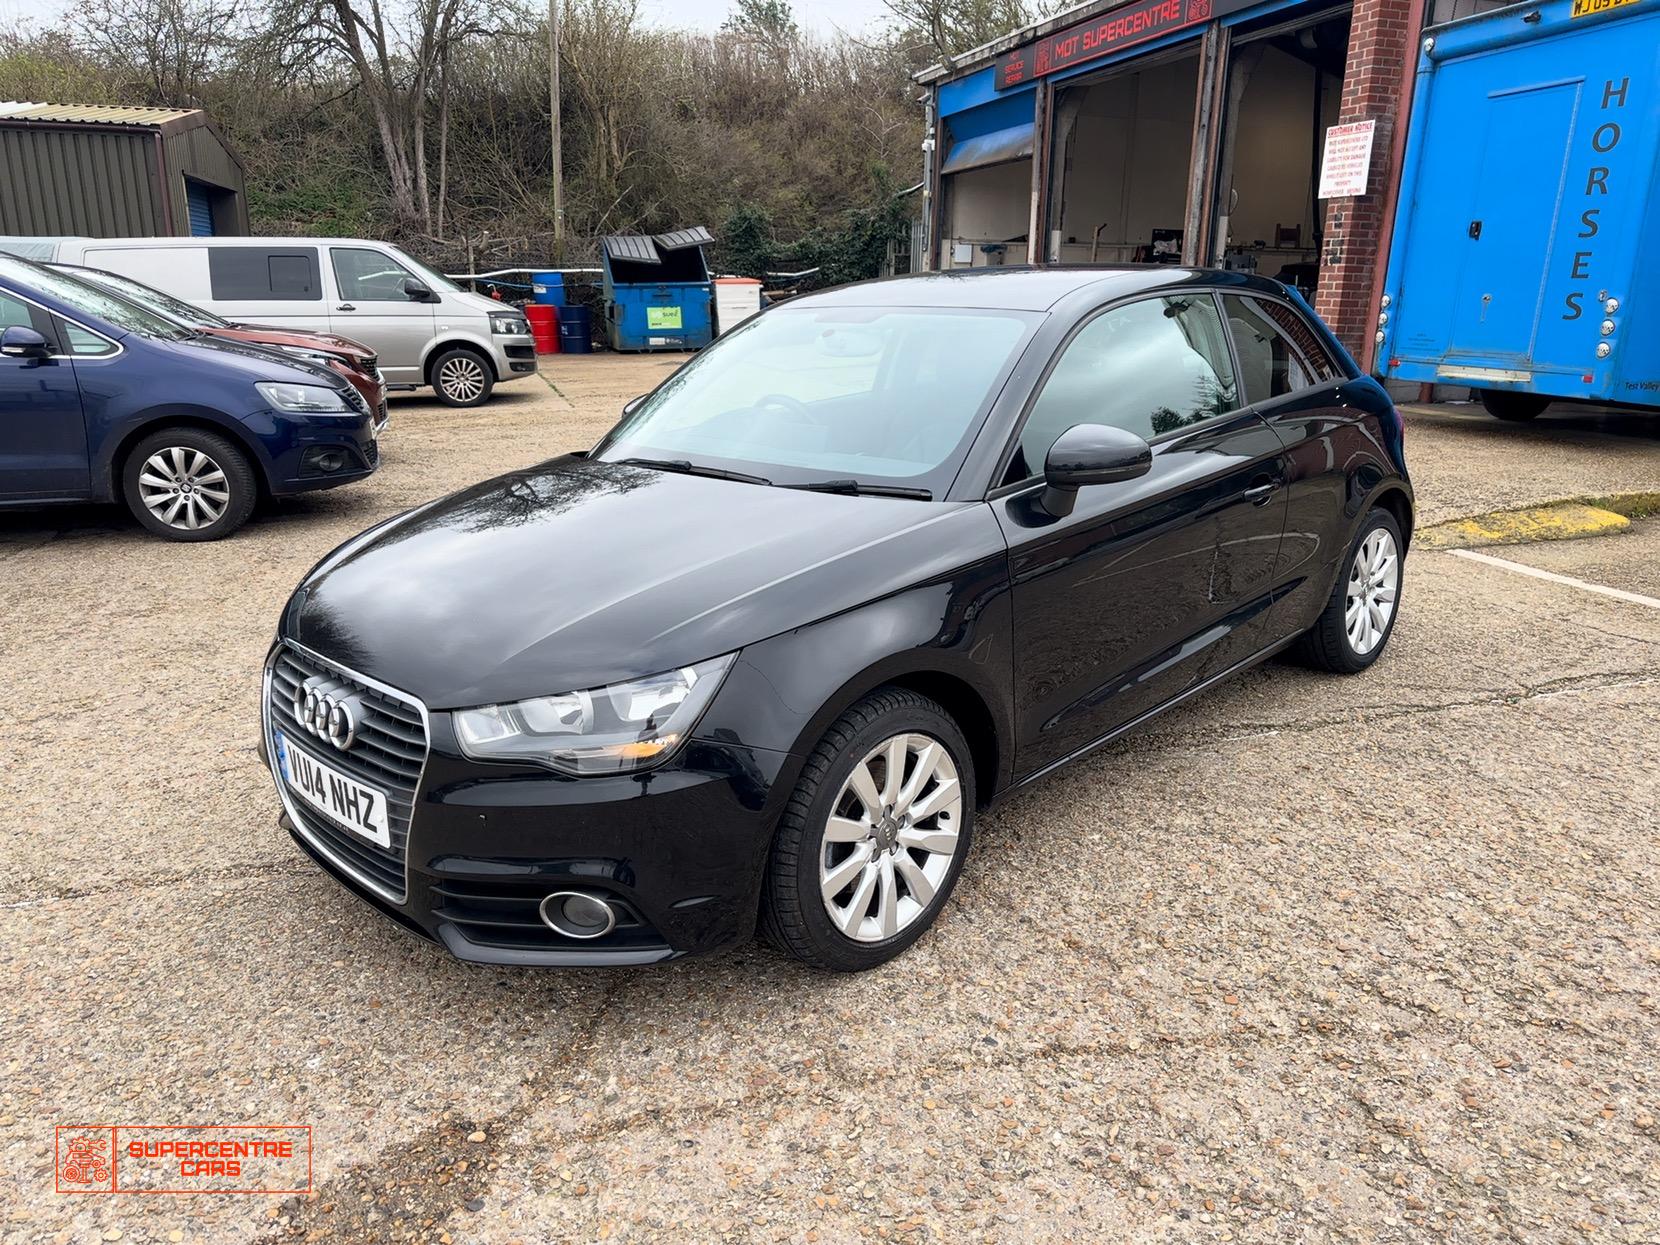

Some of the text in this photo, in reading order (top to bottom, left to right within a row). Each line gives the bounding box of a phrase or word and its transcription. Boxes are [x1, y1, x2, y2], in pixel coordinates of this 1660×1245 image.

[1054, 0, 1180, 60] MOT SUPERCENTRE
[1328, 122, 1372, 135] CUSTOMER NOTICE
[1562, 77, 1629, 320] HORSES
[329, 774, 378, 833] NHZ
